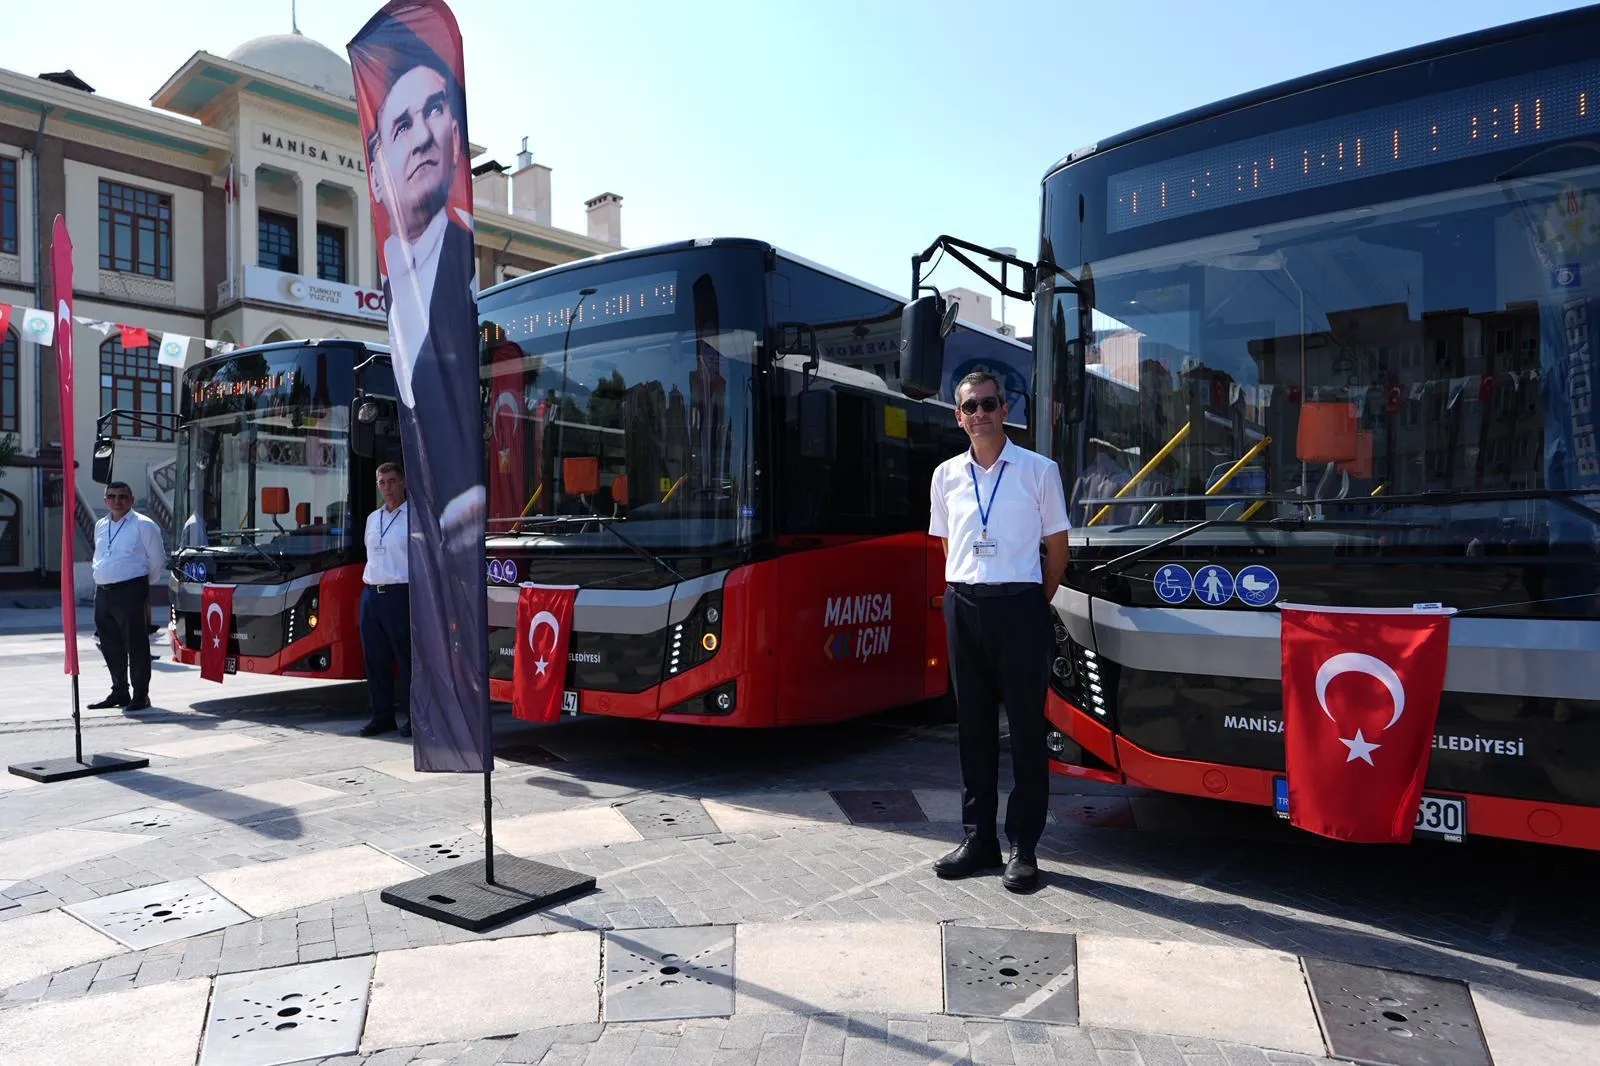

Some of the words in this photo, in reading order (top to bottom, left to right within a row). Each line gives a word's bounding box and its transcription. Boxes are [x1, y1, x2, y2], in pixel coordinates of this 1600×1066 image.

[262, 132, 328, 161] MANİSA
[824, 593, 892, 627] MANİSA
[856, 626, 891, 663] İÇİN
